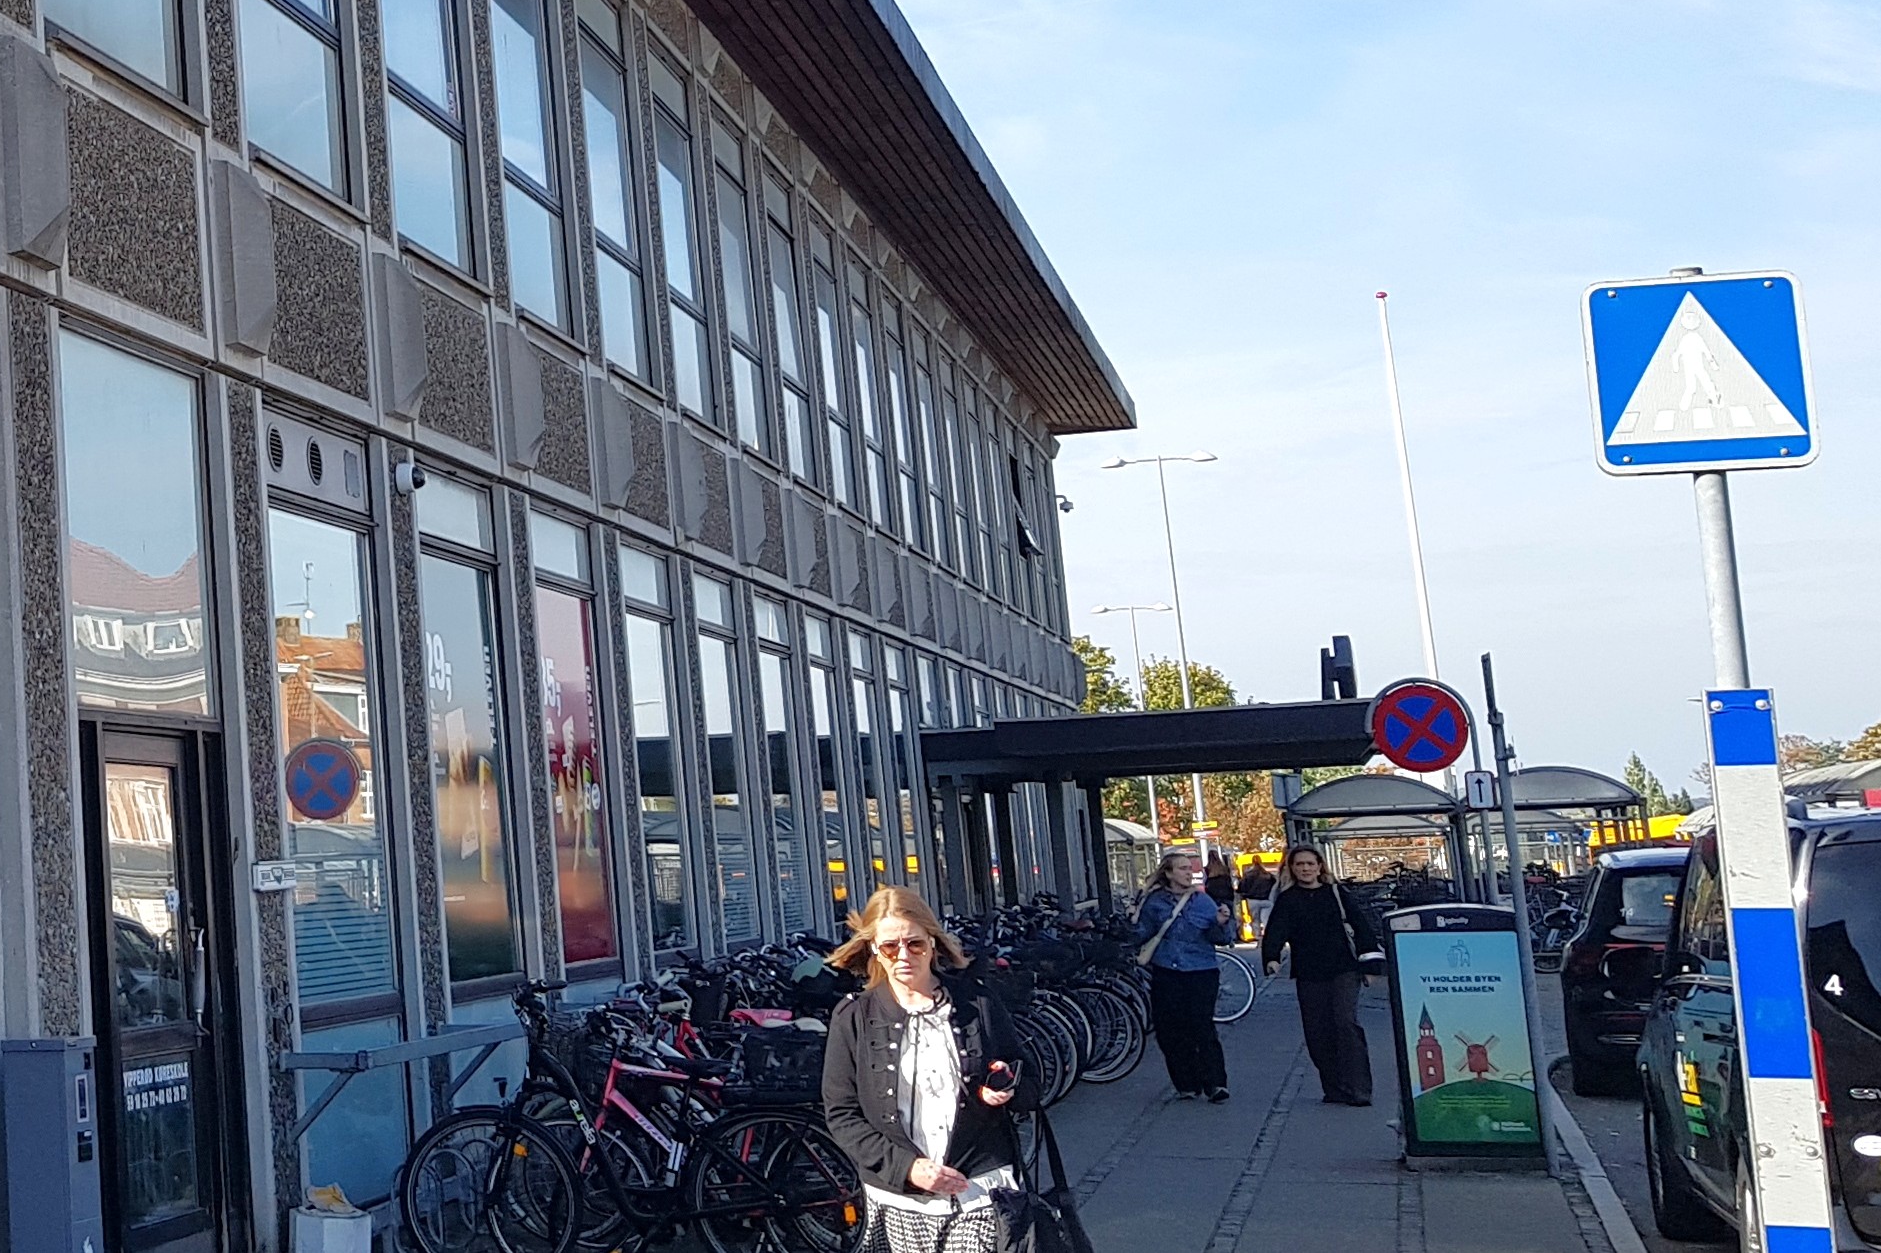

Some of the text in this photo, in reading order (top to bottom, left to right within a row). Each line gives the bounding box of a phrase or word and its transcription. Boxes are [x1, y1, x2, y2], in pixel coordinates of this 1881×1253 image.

[1420, 975, 1502, 984] VI HOLDER BYEN
[1824, 973, 1844, 996] 4
[1429, 986, 1495, 994] REN SAMMEN
